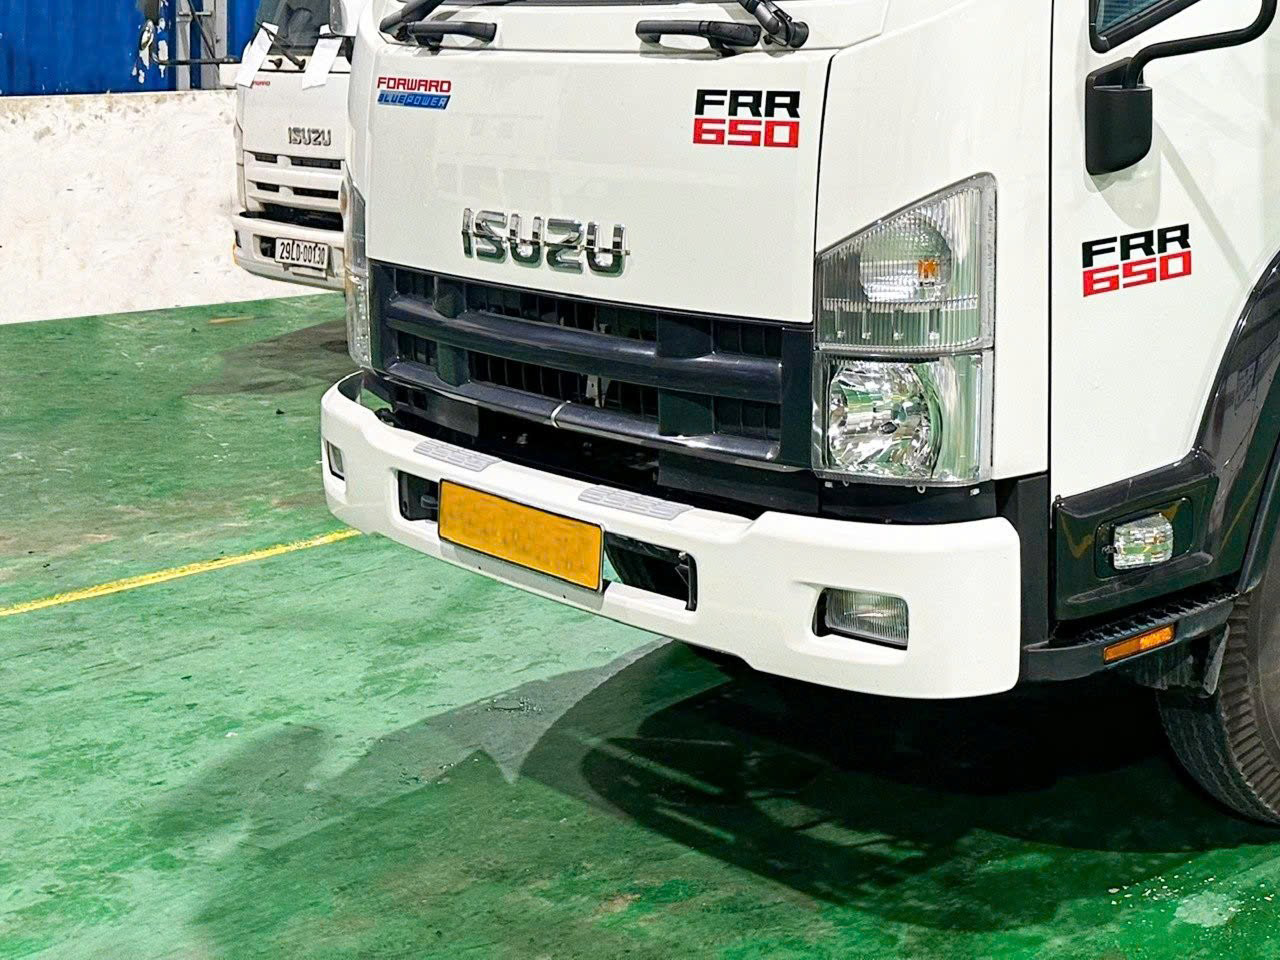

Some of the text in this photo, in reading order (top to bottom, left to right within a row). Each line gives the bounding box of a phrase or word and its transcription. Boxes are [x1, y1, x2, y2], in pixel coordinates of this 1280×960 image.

[377, 77, 452, 93] FORWARD
[695, 89, 800, 118] FRR
[288, 127, 331, 146] ISUZU
[693, 118, 799, 148] 650
[462, 208, 629, 278] ISUZU
[1082, 223, 1191, 268] FRR
[1083, 250, 1192, 297] 650
